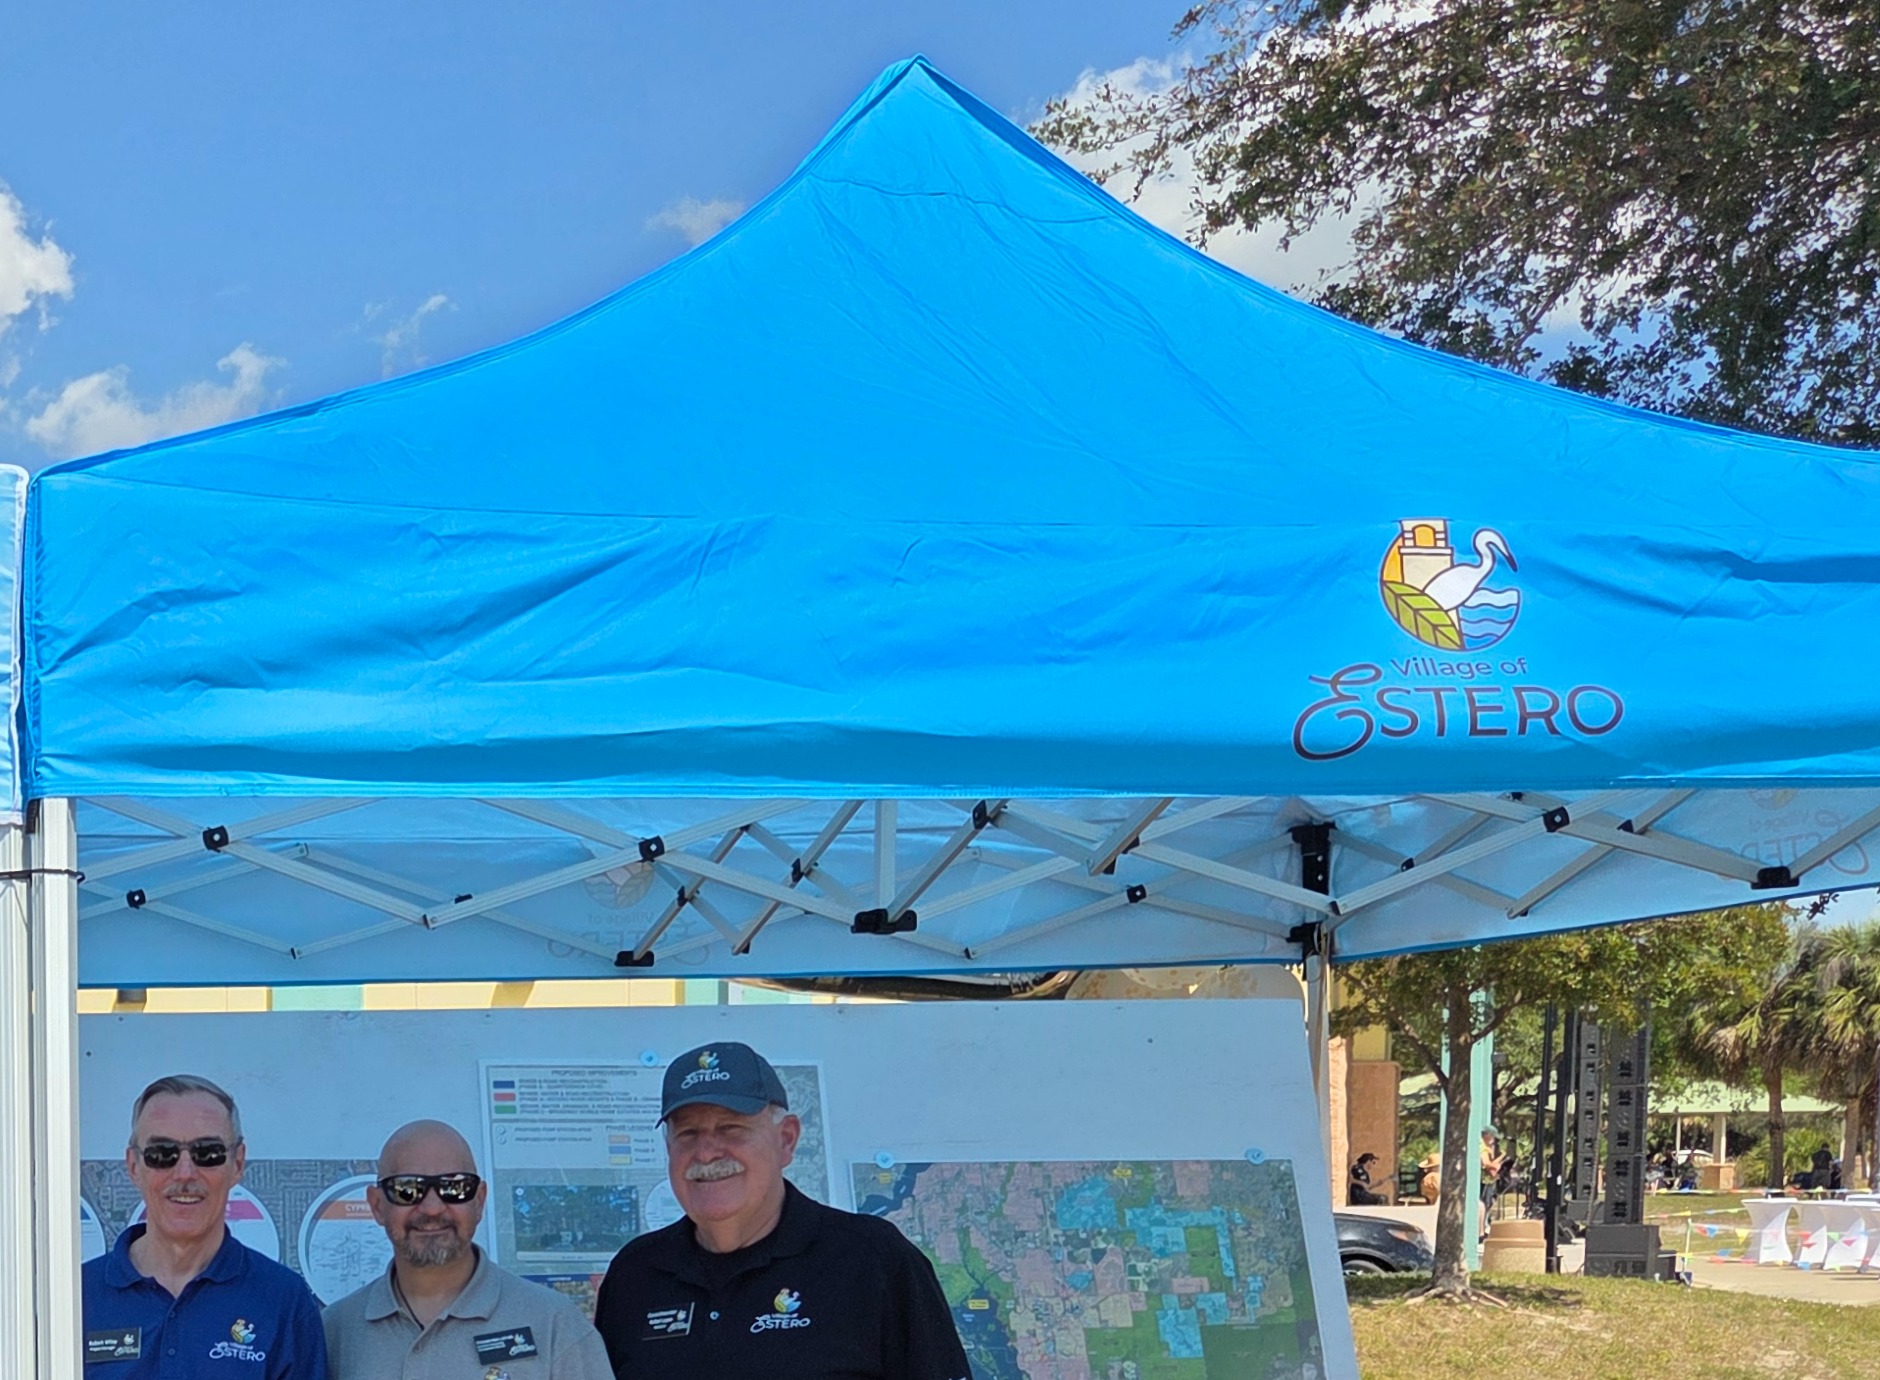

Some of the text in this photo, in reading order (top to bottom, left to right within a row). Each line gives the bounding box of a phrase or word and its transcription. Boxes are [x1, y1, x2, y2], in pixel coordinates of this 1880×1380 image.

[1390, 656, 1528, 680] Village of
[1292, 663, 1624, 762] ESTERO
